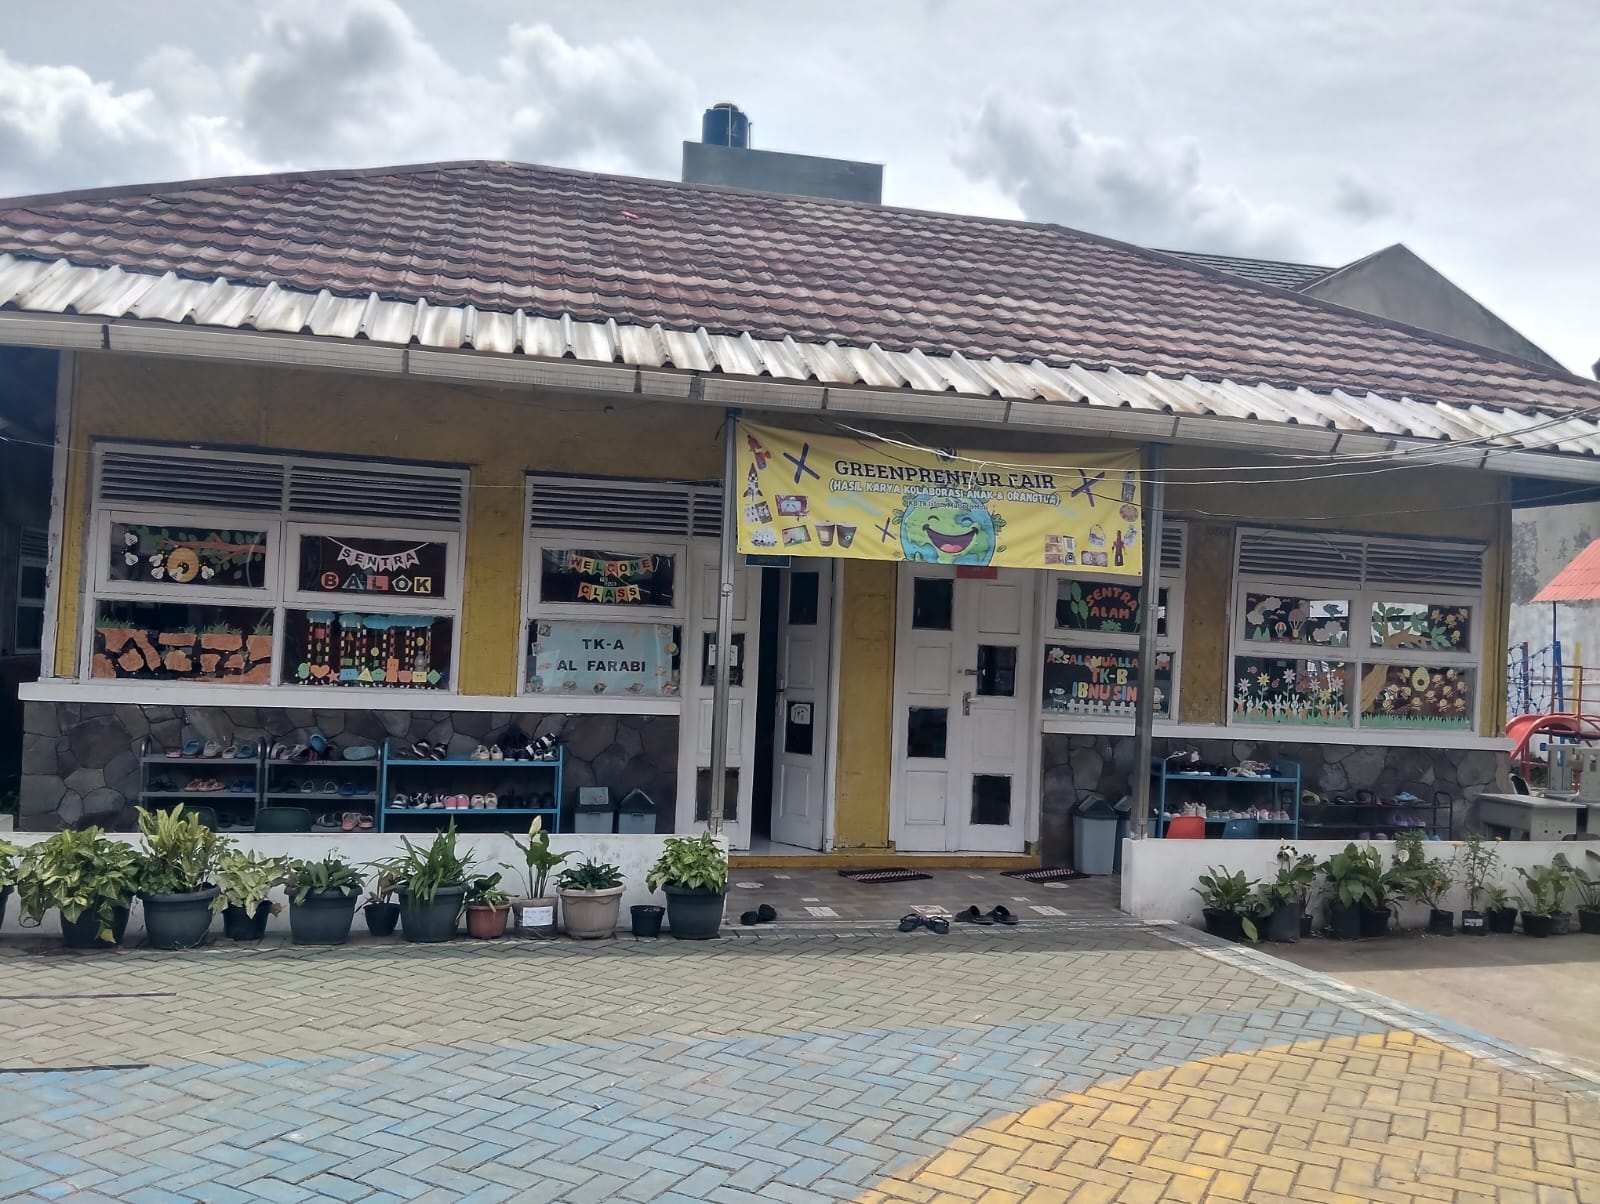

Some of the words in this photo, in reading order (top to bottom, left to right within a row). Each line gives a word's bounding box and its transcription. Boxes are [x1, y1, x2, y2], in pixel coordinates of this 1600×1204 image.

[834, 460, 1001, 487] GREENPRENEUR
[1008, 473, 1057, 489] FAIR
[829, 479, 862, 492] (HASIL
[866, 481, 901, 493] KARYA
[903, 484, 963, 499] KOLABORASI
[966, 488, 993, 499] ANAK
[341, 548, 416, 567] SENTRA
[570, 556, 650, 573] WELCOME
[322, 573, 431, 593] BALOK
[580, 584, 638, 599] CLASS
[1086, 586, 1138, 612] SENTRA
[1090, 606, 1130, 619] ALAM
[582, 638, 624, 650] TK-A
[557, 660, 577, 671] AL
[587, 660, 646, 672] FARABI
[1090, 668, 1128, 686] TK-B
[1071, 682, 1111, 700] IBNU
[1113, 685, 1138, 701] SIN
